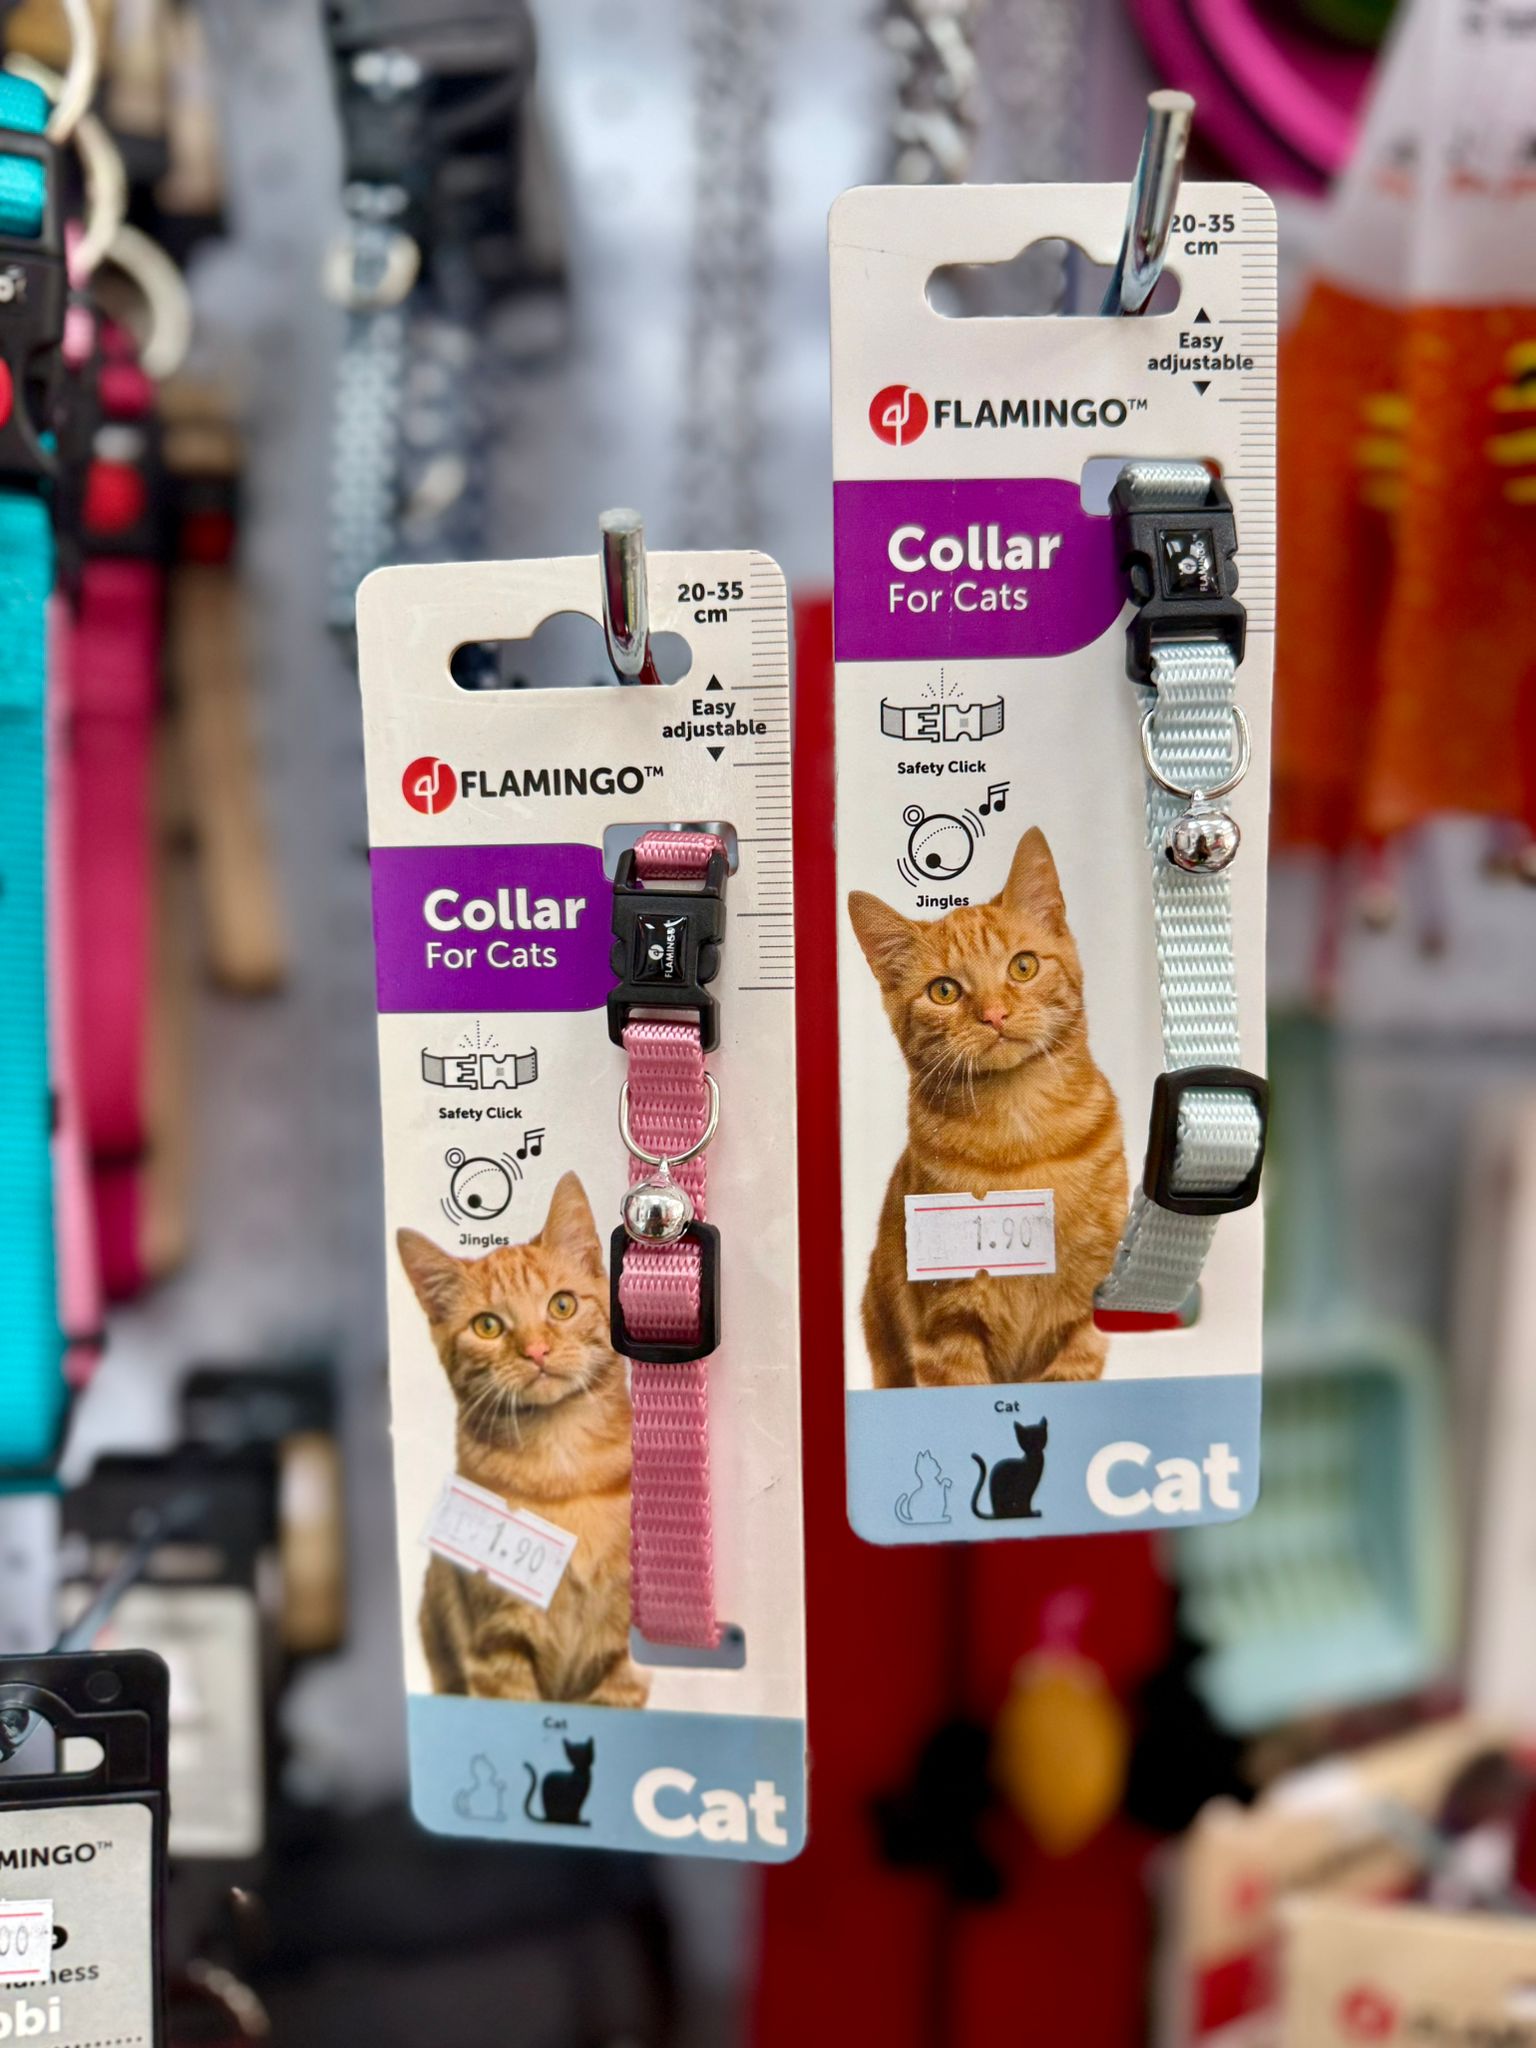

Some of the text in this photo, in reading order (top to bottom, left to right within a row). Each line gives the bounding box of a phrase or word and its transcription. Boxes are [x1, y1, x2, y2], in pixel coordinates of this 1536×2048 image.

[1184, 241, 1218, 255] cm
[1179, 332, 1224, 353] Easy
[1148, 353, 1254, 375] adjustable
[887, 525, 1061, 573] Collar
[677, 581, 744, 603] 20-35
[889, 581, 1028, 613] For Cats
[694, 608, 728, 624] cm
[692, 699, 736, 719] Easy
[662, 719, 767, 741] adjustable
[897, 760, 986, 777] Safety Click
[423, 888, 586, 932] Collar
[916, 894, 970, 909] Jingles
[426, 940, 557, 969] For Cats
[438, 1107, 522, 1122] Safety Click
[459, 1233, 510, 1248] Jingles
[973, 1215, 1033, 1251] 1.90
[994, 1400, 1020, 1413] Cat
[1086, 1441, 1241, 1517] Cat
[489, 1521, 546, 1574] 1.90
[543, 1717, 567, 1730] Cat
[632, 1767, 788, 1847] Cat
